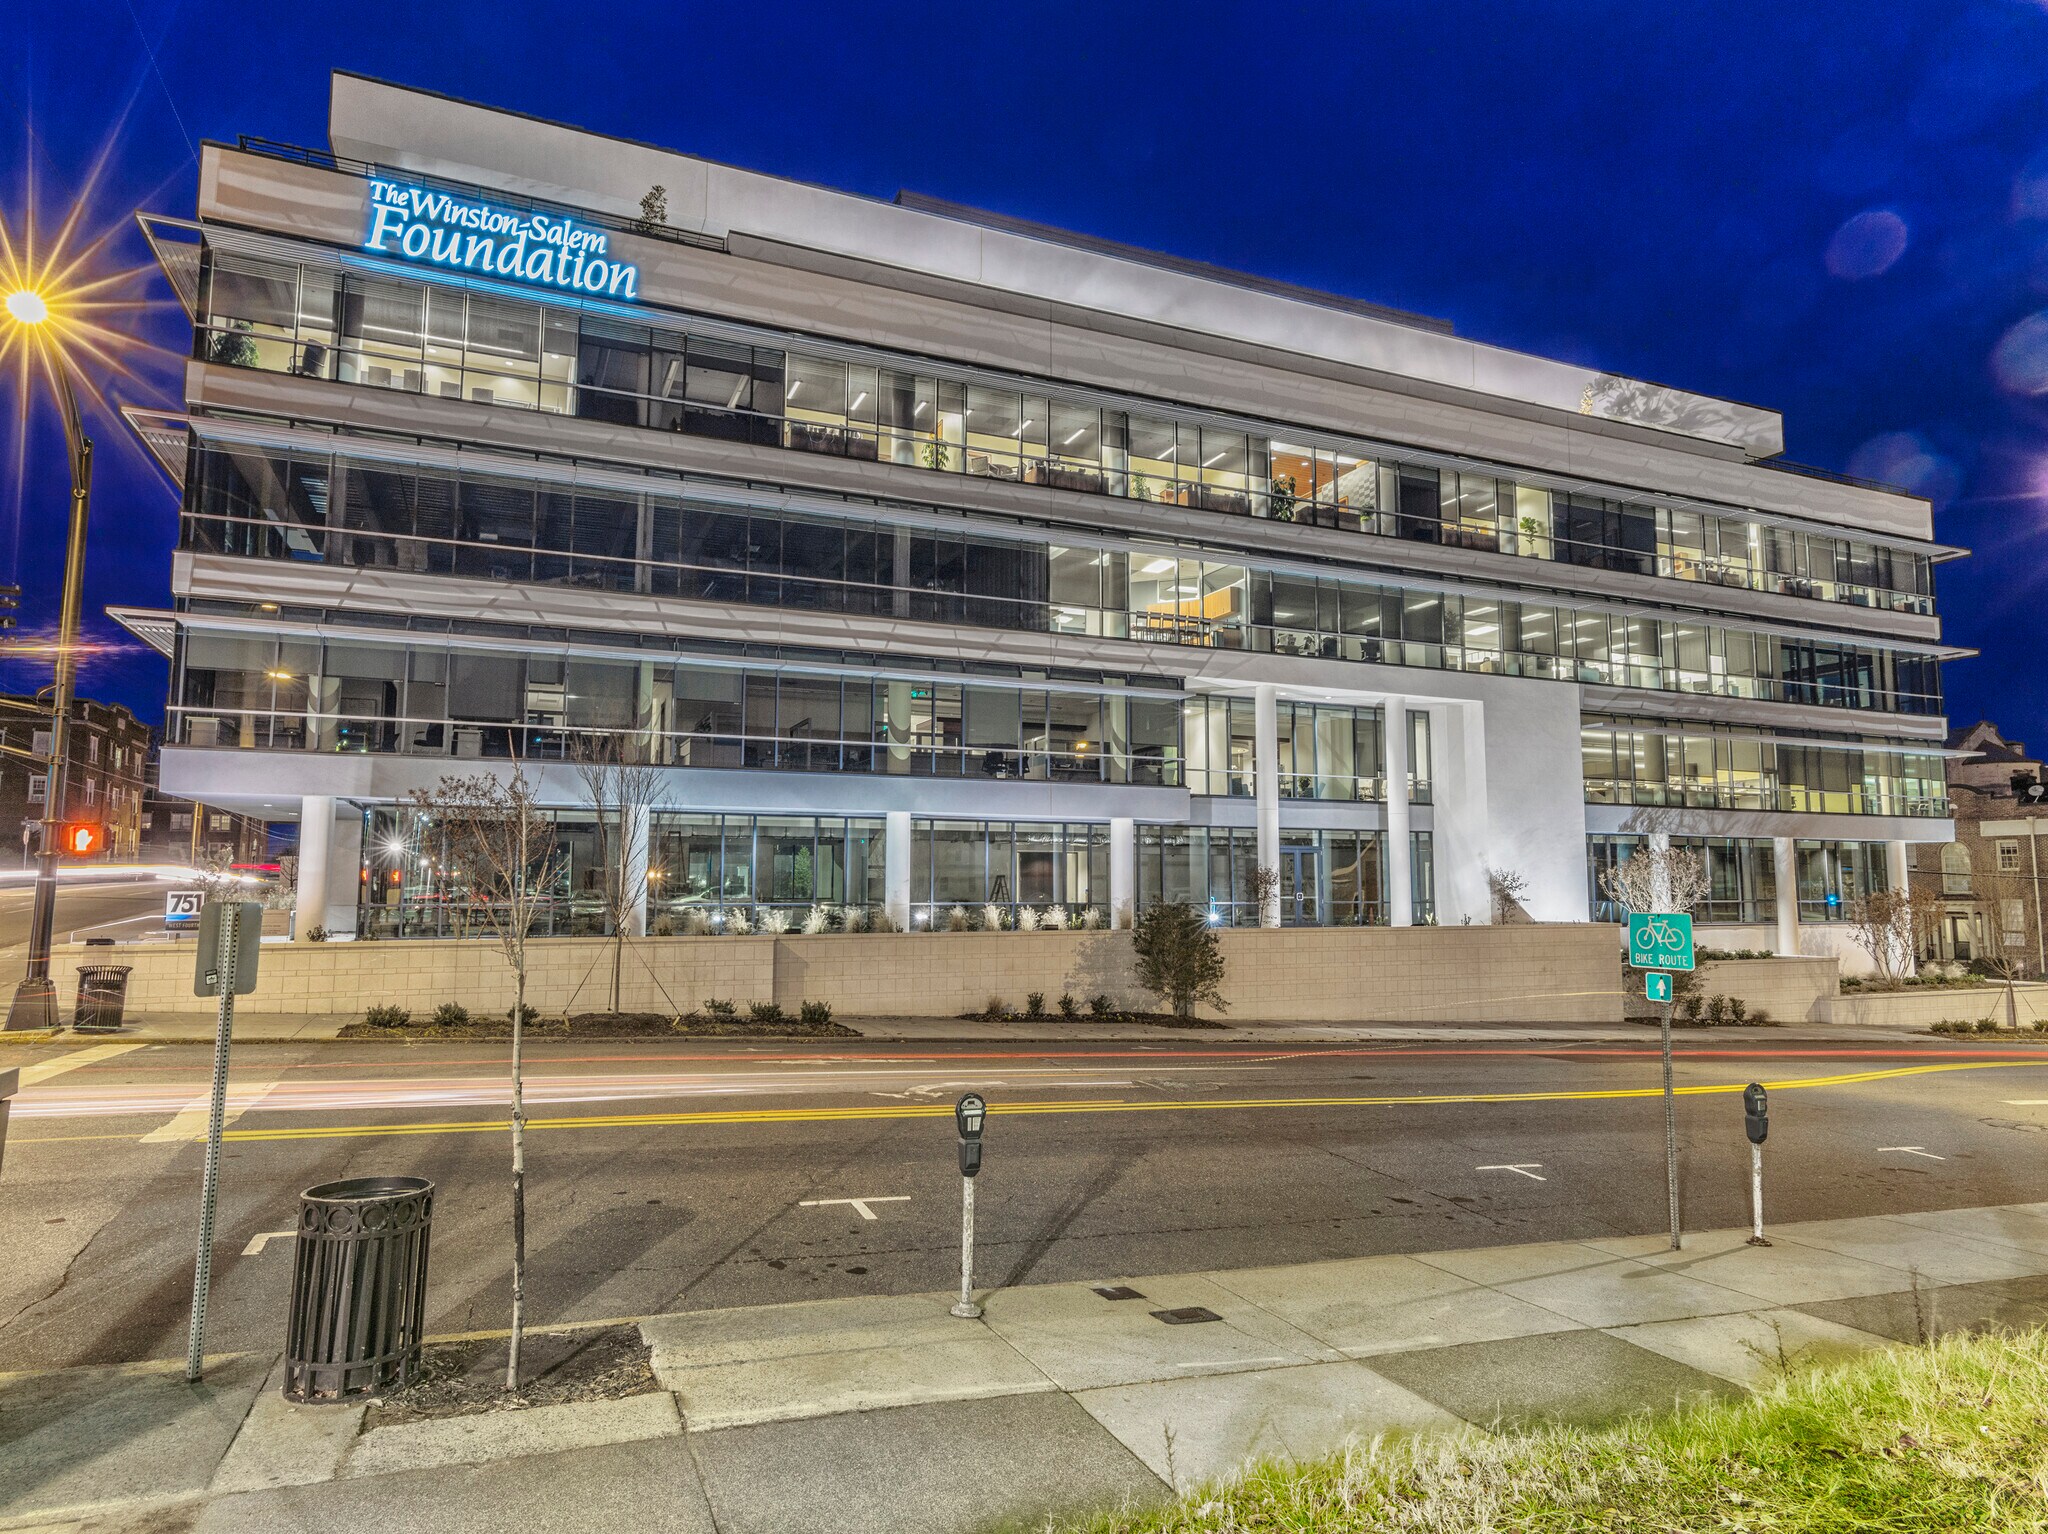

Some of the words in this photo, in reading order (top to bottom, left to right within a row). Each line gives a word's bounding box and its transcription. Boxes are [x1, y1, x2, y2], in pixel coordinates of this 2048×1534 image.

[371, 181, 409, 206] The
[408, 188, 605, 254] Winston-Salem
[365, 203, 636, 298] Foundation
[170, 894, 202, 912] 751
[1635, 953, 1653, 964] BIKE
[1659, 954, 1689, 966] ROUTE
